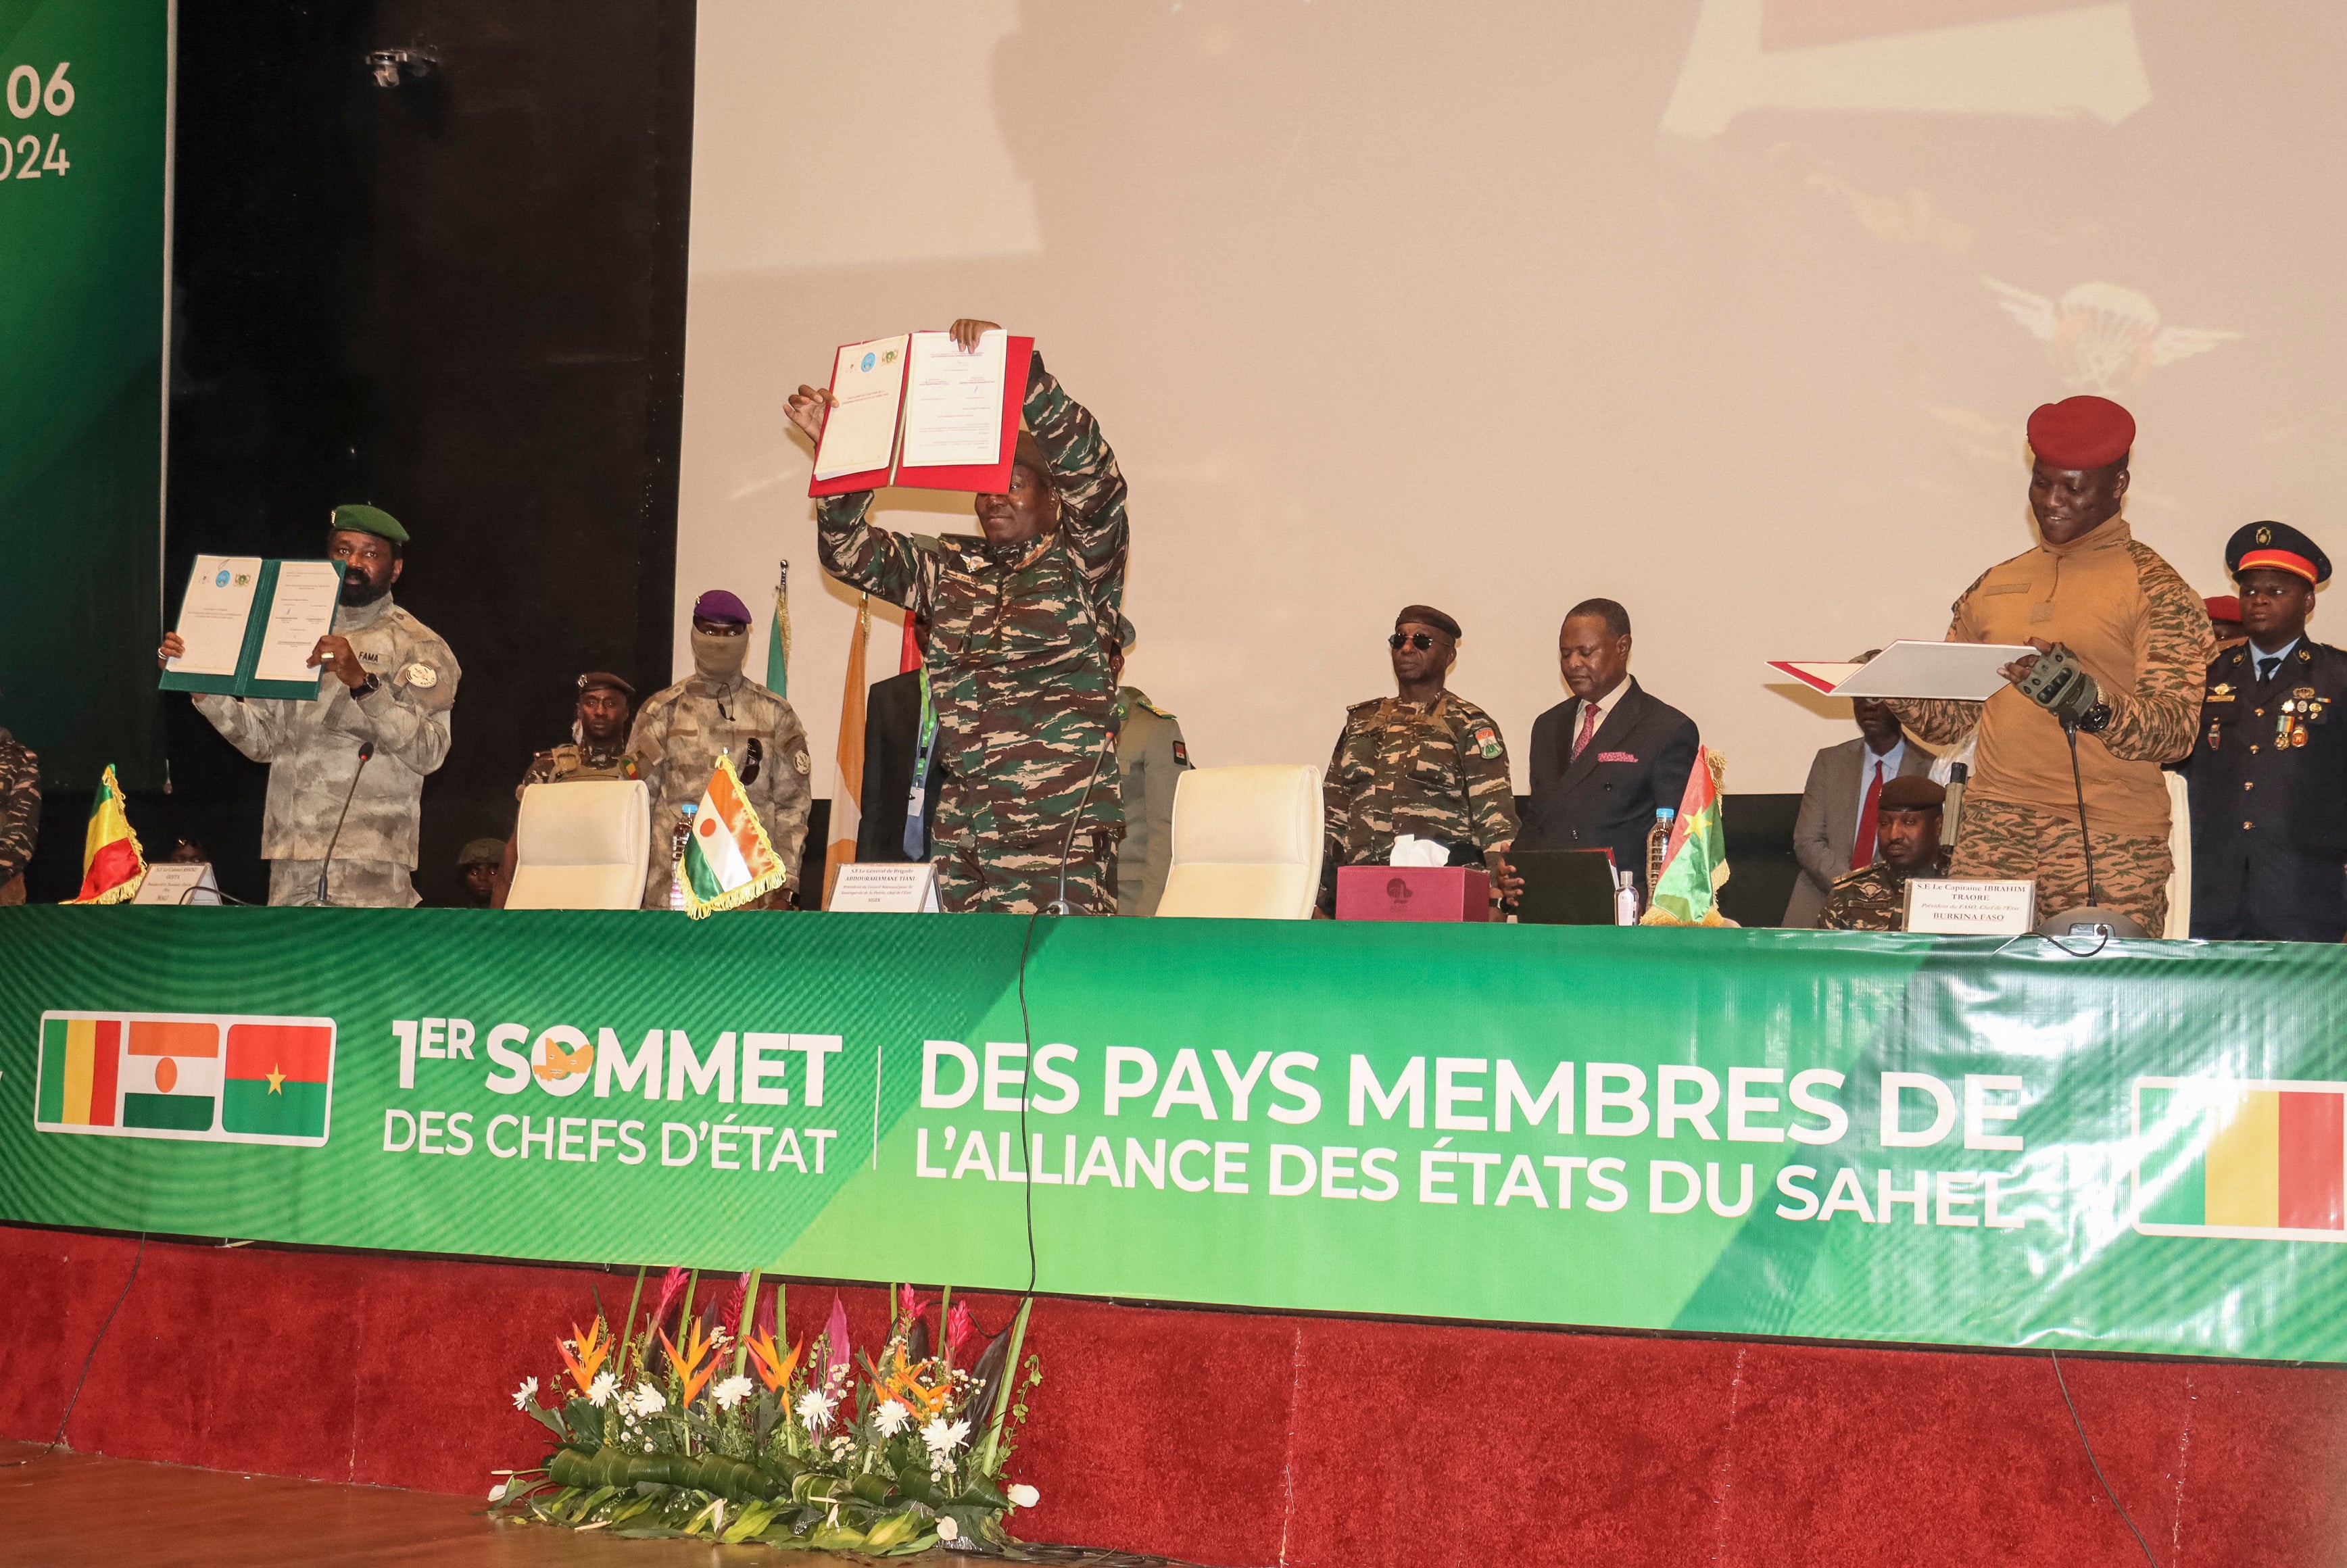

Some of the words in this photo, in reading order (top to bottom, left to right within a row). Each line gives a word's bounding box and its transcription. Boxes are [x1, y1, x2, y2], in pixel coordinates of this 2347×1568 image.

[7, 62, 76, 119] 06
[358, 651, 379, 663] FAMA
[393, 1017, 476, 1089] 1ER
[485, 1023, 843, 1106] SOMMET
[920, 1040, 1080, 1114] DES
[1104, 1046, 1322, 1125] PAYS
[1349, 1054, 1849, 1146] MEMBRES
[1880, 1071, 2024, 1151] DE
[383, 1109, 474, 1156] DES
[486, 1114, 648, 1165] CHEFS
[662, 1113, 838, 1174] D'ÉTAT
[916, 1127, 1250, 1194] L'ALLIANCE
[1269, 1144, 1399, 1202] DES
[1420, 1137, 1629, 1212] ÉTATS
[1649, 1160, 1754, 1219] DU
[1775, 1165, 2025, 1229] SAHEL
